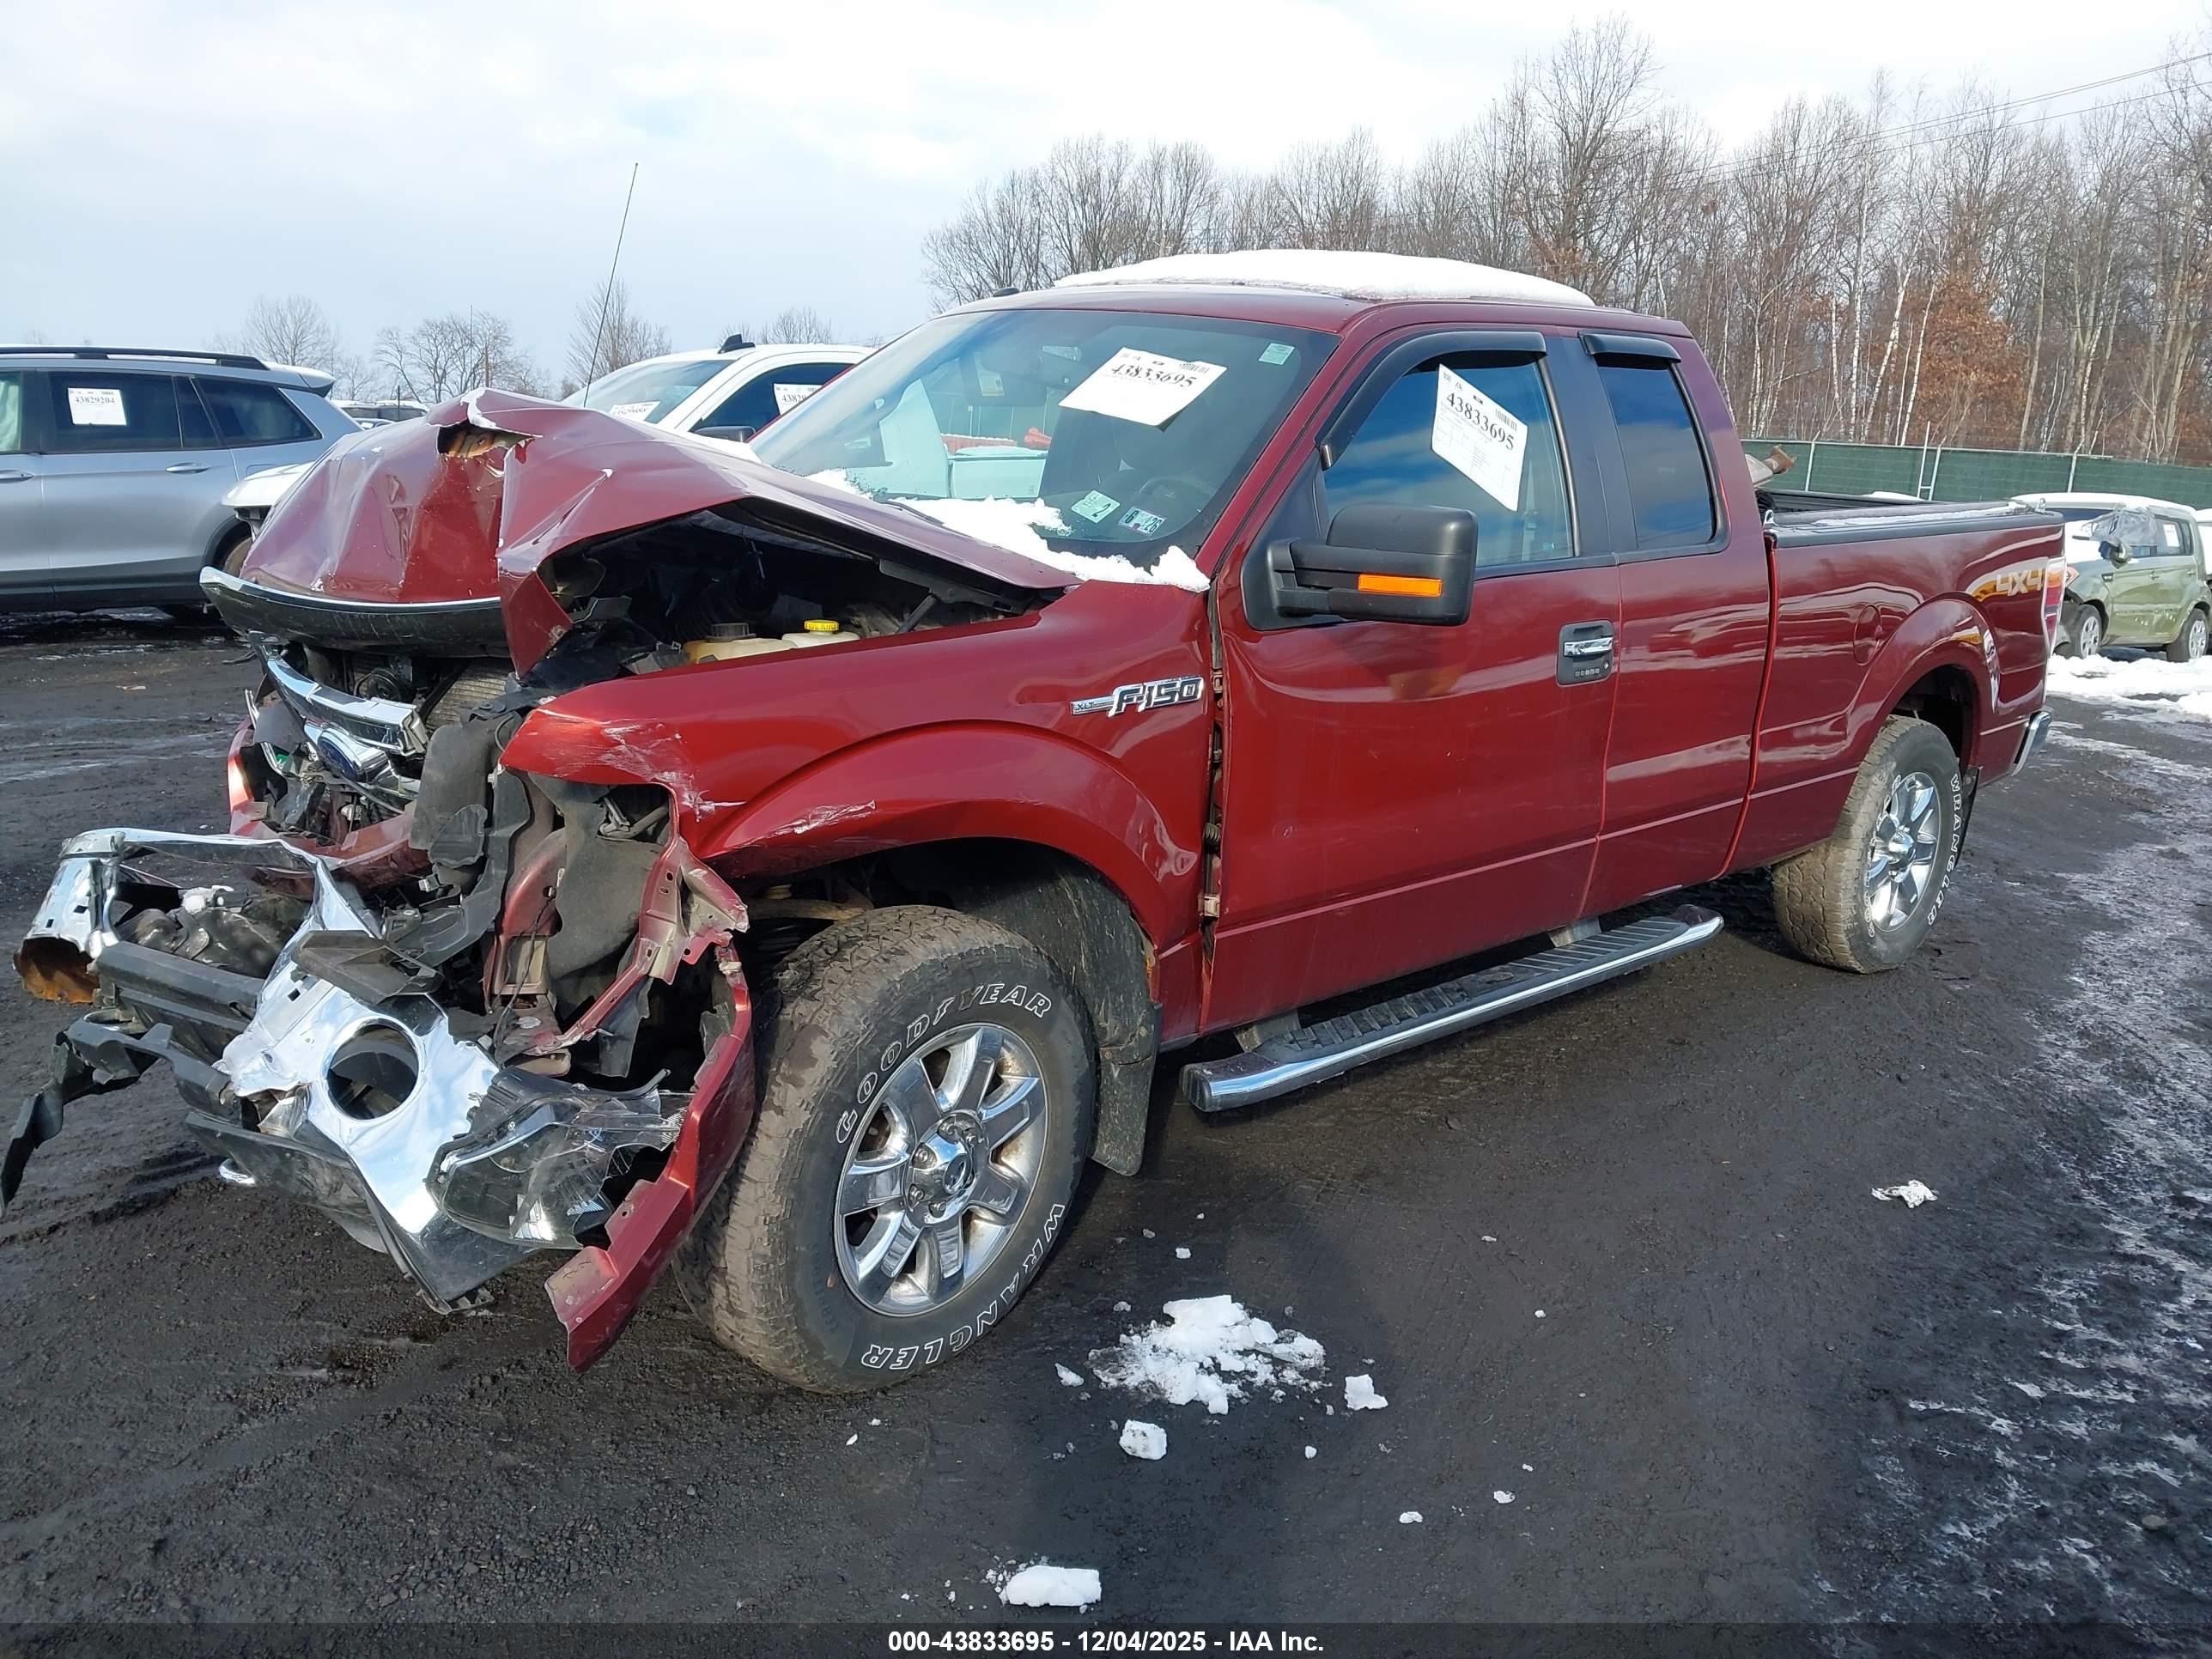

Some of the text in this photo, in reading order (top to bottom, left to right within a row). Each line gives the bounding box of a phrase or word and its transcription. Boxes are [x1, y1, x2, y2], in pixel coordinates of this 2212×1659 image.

[1111, 363, 1198, 387] 43833695
[1446, 392, 1515, 451] 43833695
[1927, 774, 1962, 926] WRANGLER
[836, 982, 1052, 1144] GOODYEAR
[861, 1204, 1066, 1370] WRANGLER
